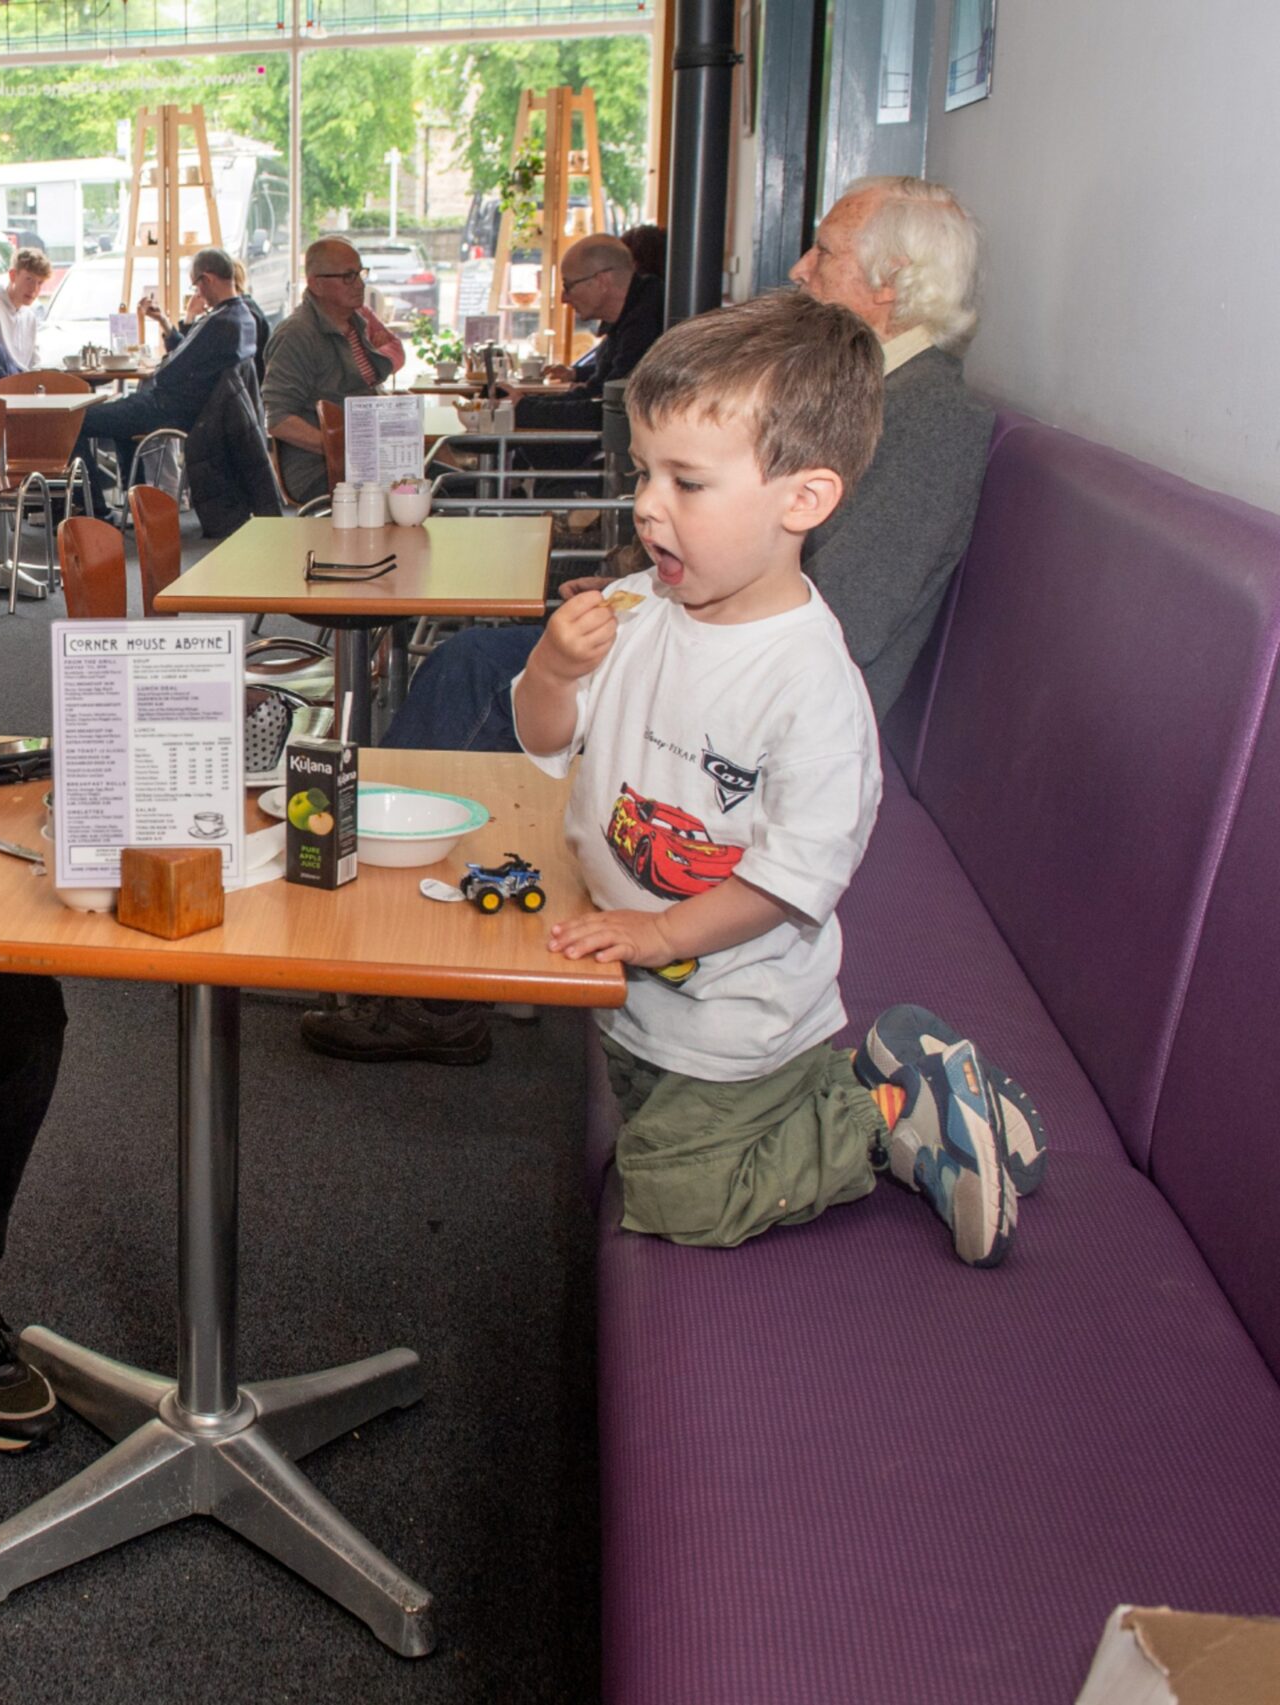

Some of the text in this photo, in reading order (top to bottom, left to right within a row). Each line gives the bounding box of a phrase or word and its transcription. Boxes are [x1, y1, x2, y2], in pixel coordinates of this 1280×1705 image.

[70, 637, 224, 651] CORNER HOUSE ABOYNE
[668, 743, 696, 763] PIXAR
[290, 755, 332, 774] Kulana
[707, 760, 754, 788] Car
[301, 845, 320, 854] PURE
[300, 853, 321, 862] APPLE
[301, 860, 320, 869] JUICE
